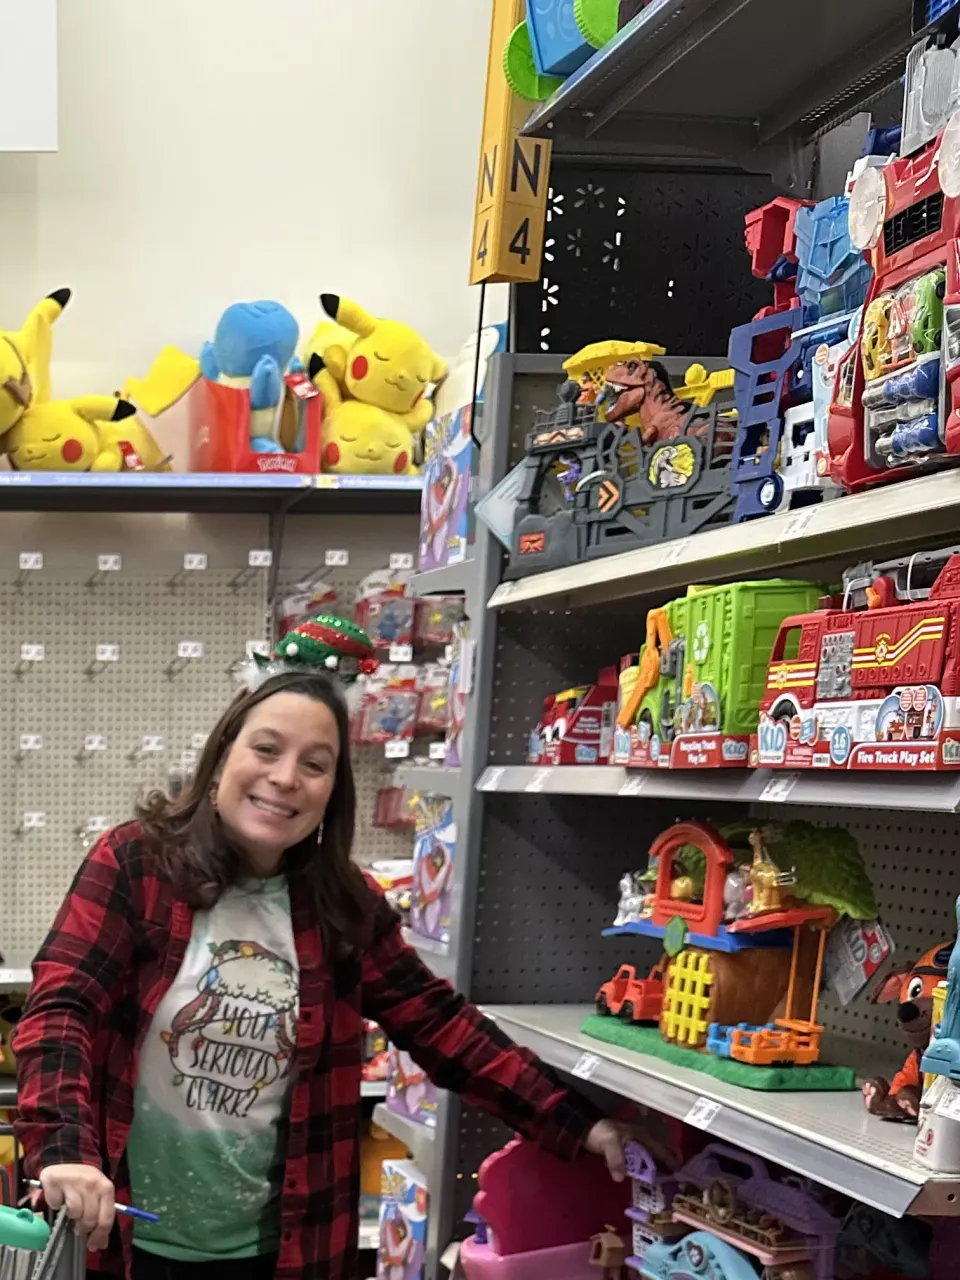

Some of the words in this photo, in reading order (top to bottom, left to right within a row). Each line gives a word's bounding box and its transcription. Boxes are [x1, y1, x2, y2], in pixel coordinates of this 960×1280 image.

[479, 144, 498, 204] N
[510, 138, 542, 198] N
[476, 219, 489, 267] 4
[508, 217, 531, 265] 4
[759, 726, 786, 751] KID
[833, 731, 846, 748] 16
[857, 750, 874, 764] Fire
[875, 750, 898, 764] Truck
[899, 750, 918, 767] Play
[919, 750, 935, 763] Set
[189, 1042, 272, 1082] SERIOUS
[185, 1075, 260, 1118] CLARK?
